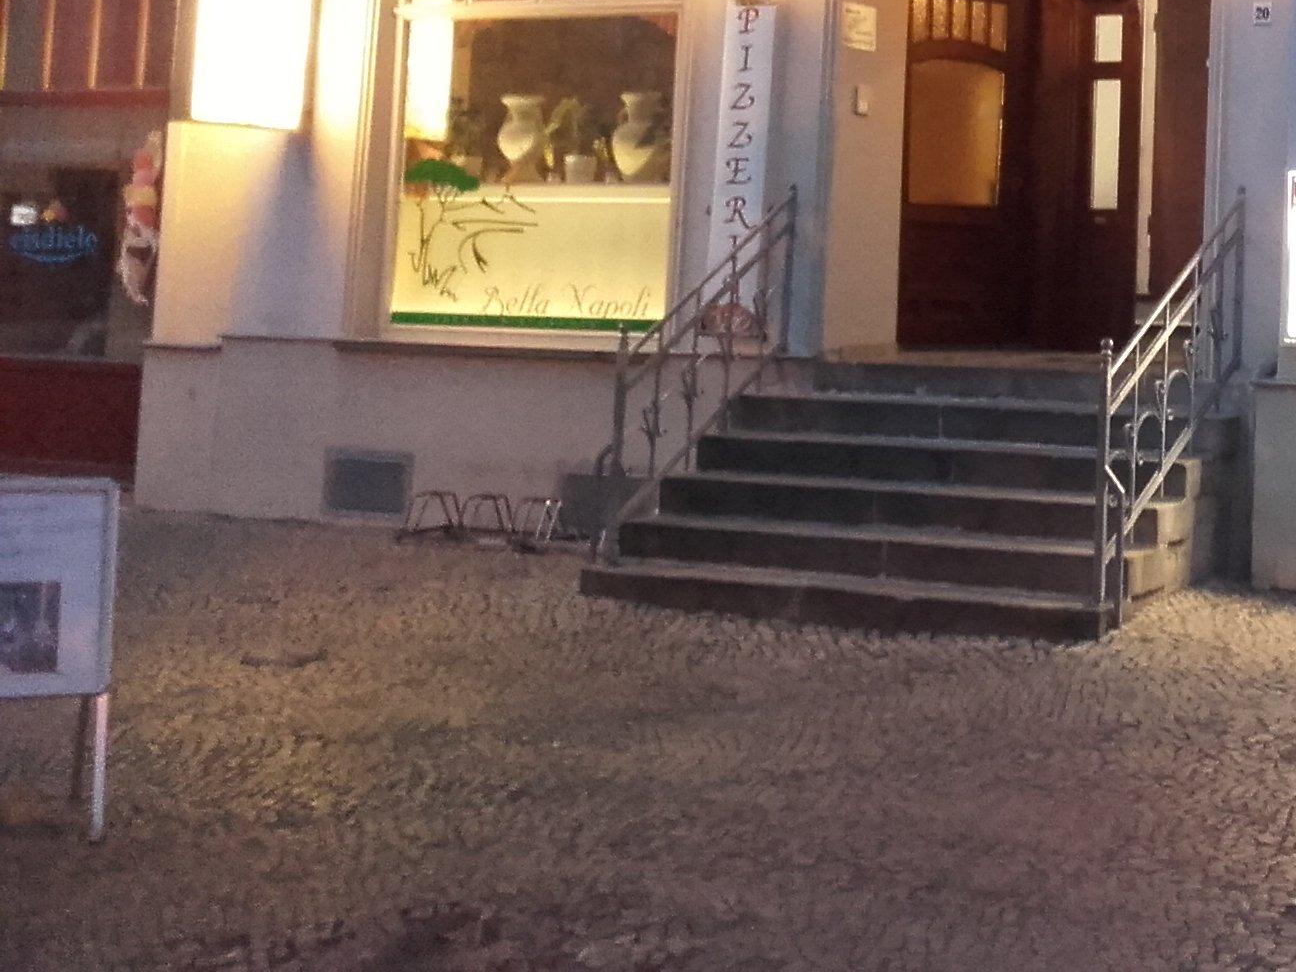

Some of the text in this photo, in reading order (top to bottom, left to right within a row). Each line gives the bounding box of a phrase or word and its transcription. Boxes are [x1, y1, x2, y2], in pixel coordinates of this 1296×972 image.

[1255, 6, 1270, 19] 20
[481, 282, 651, 318] Bella Napoli
